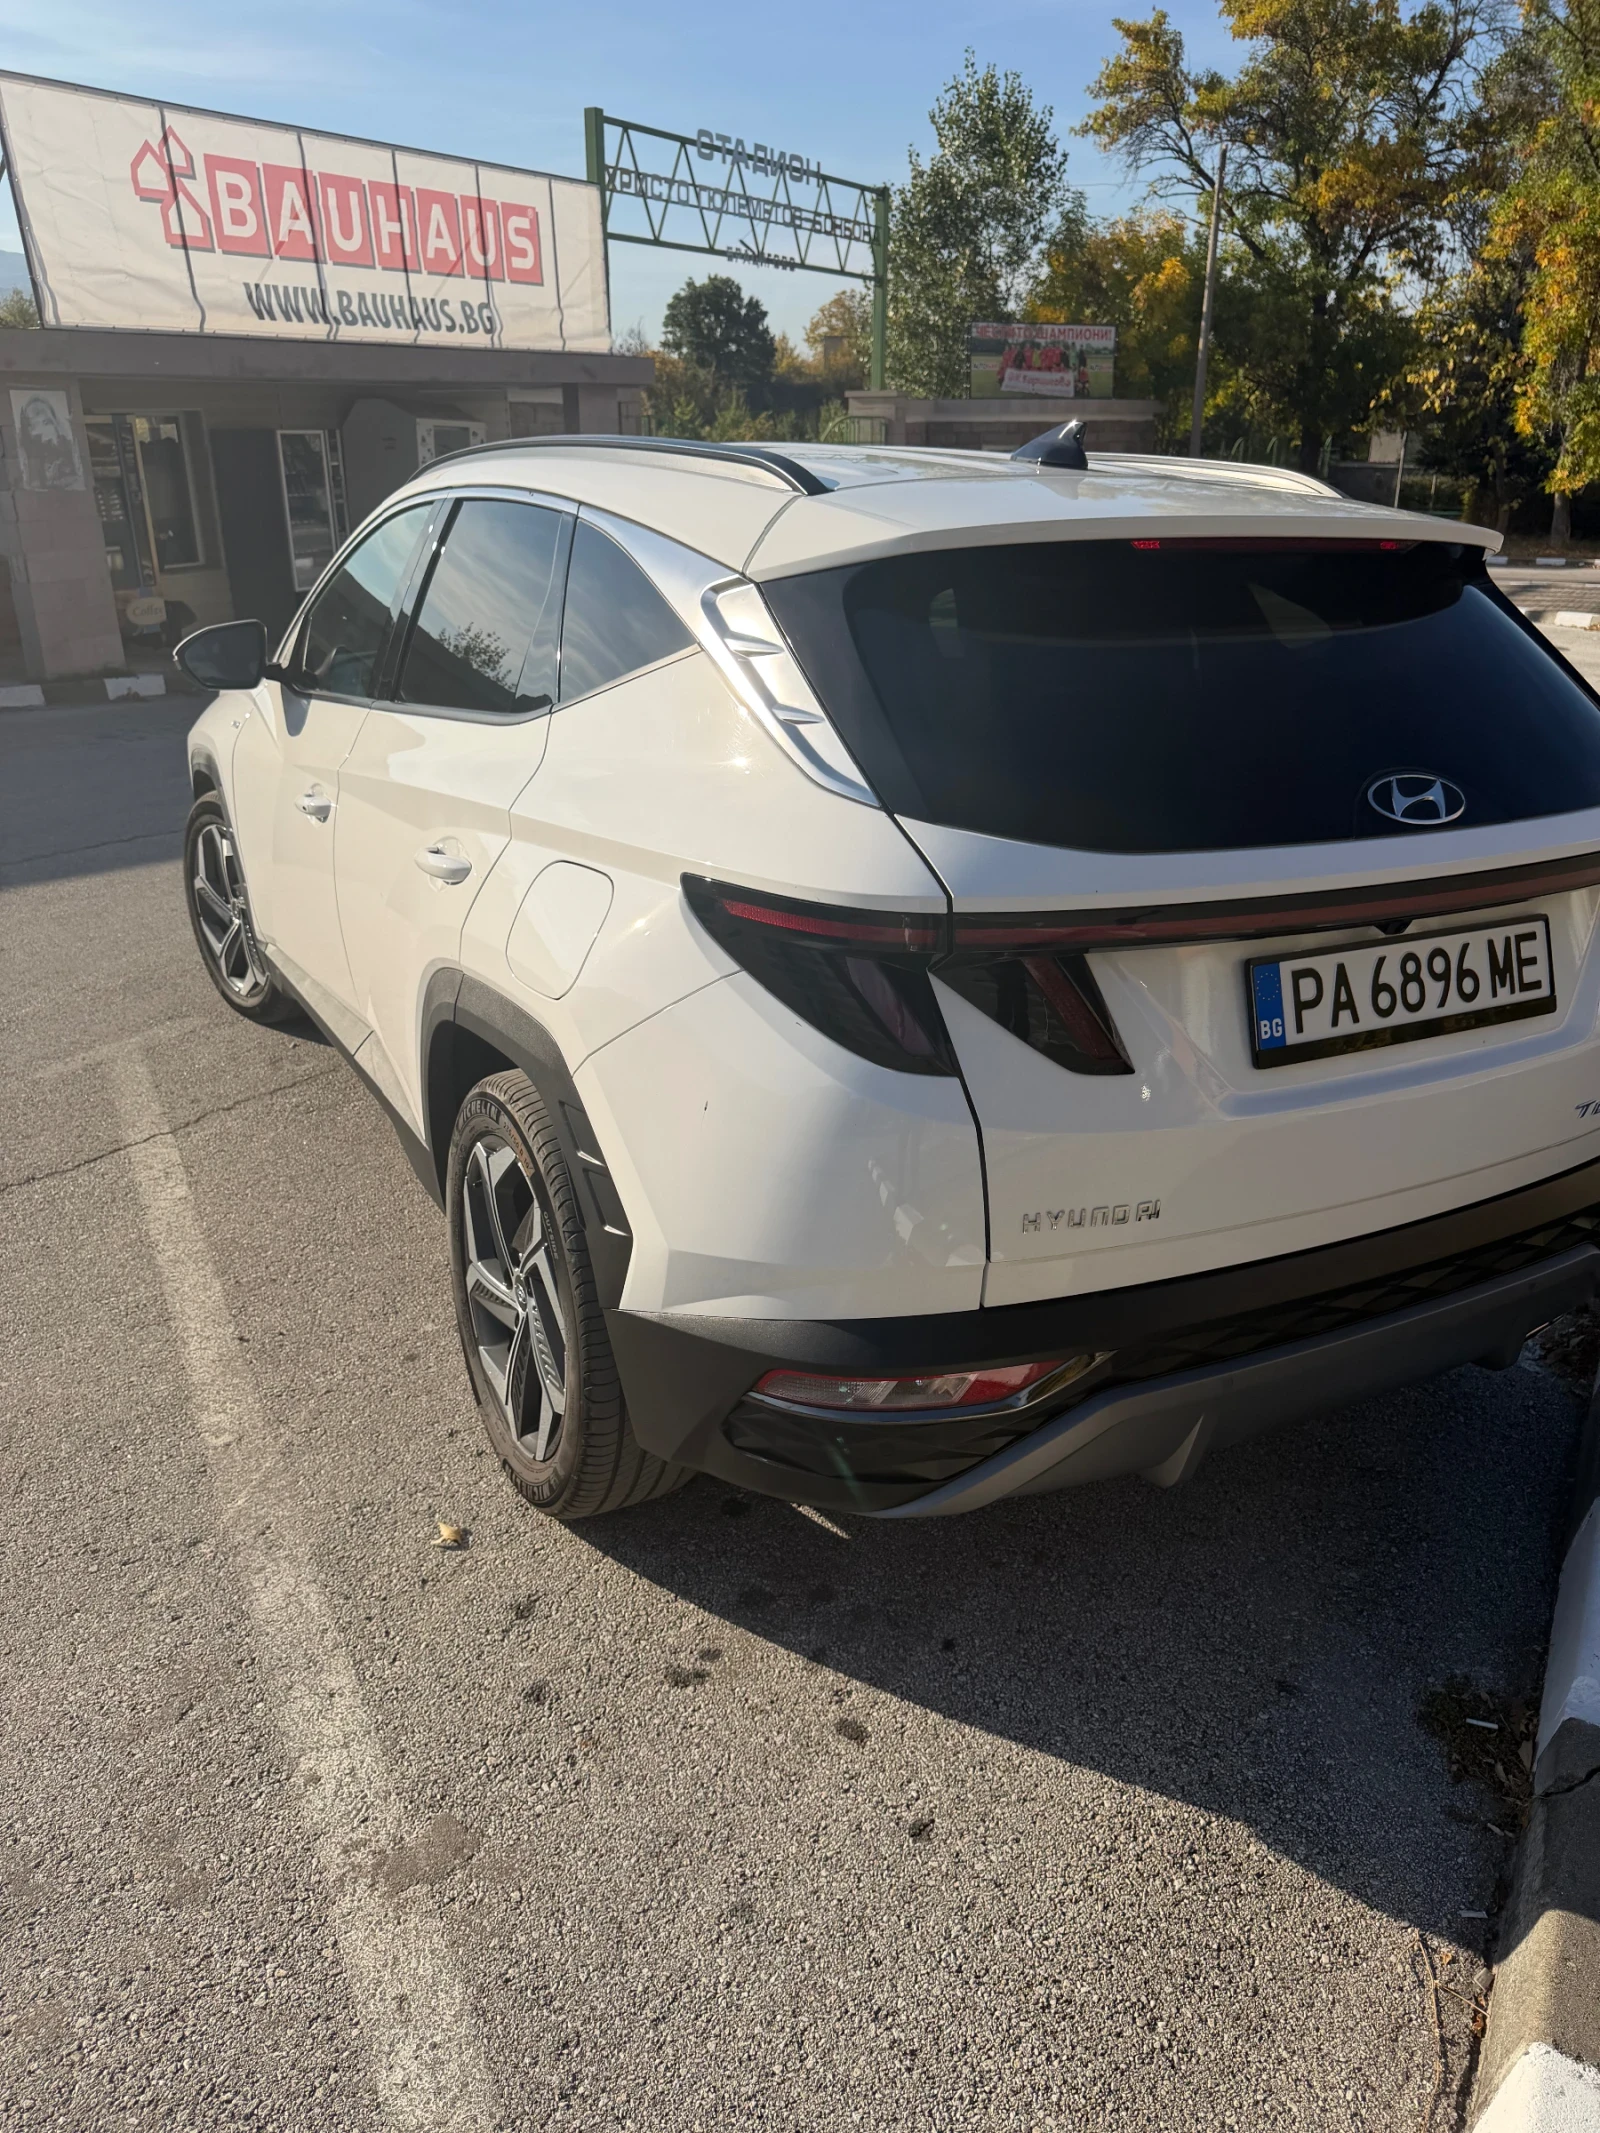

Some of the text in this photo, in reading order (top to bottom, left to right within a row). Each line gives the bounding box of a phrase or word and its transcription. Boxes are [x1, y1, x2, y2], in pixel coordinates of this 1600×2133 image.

[696, 128, 821, 188] СТАДИОН
[604, 166, 690, 206] ХРИСТО
[213, 169, 535, 270] BAUHAUS
[245, 282, 495, 334] WWW.BAUHAUS.BG
[1036, 326, 1112, 341] ШАМПИОНИ!
[1291, 931, 1543, 1035] PA 6896 ME
[1260, 1018, 1283, 1040] BG
[543, 1211, 558, 1259] OUTSIDE
[1022, 1199, 1161, 1234] HYUNDAI
